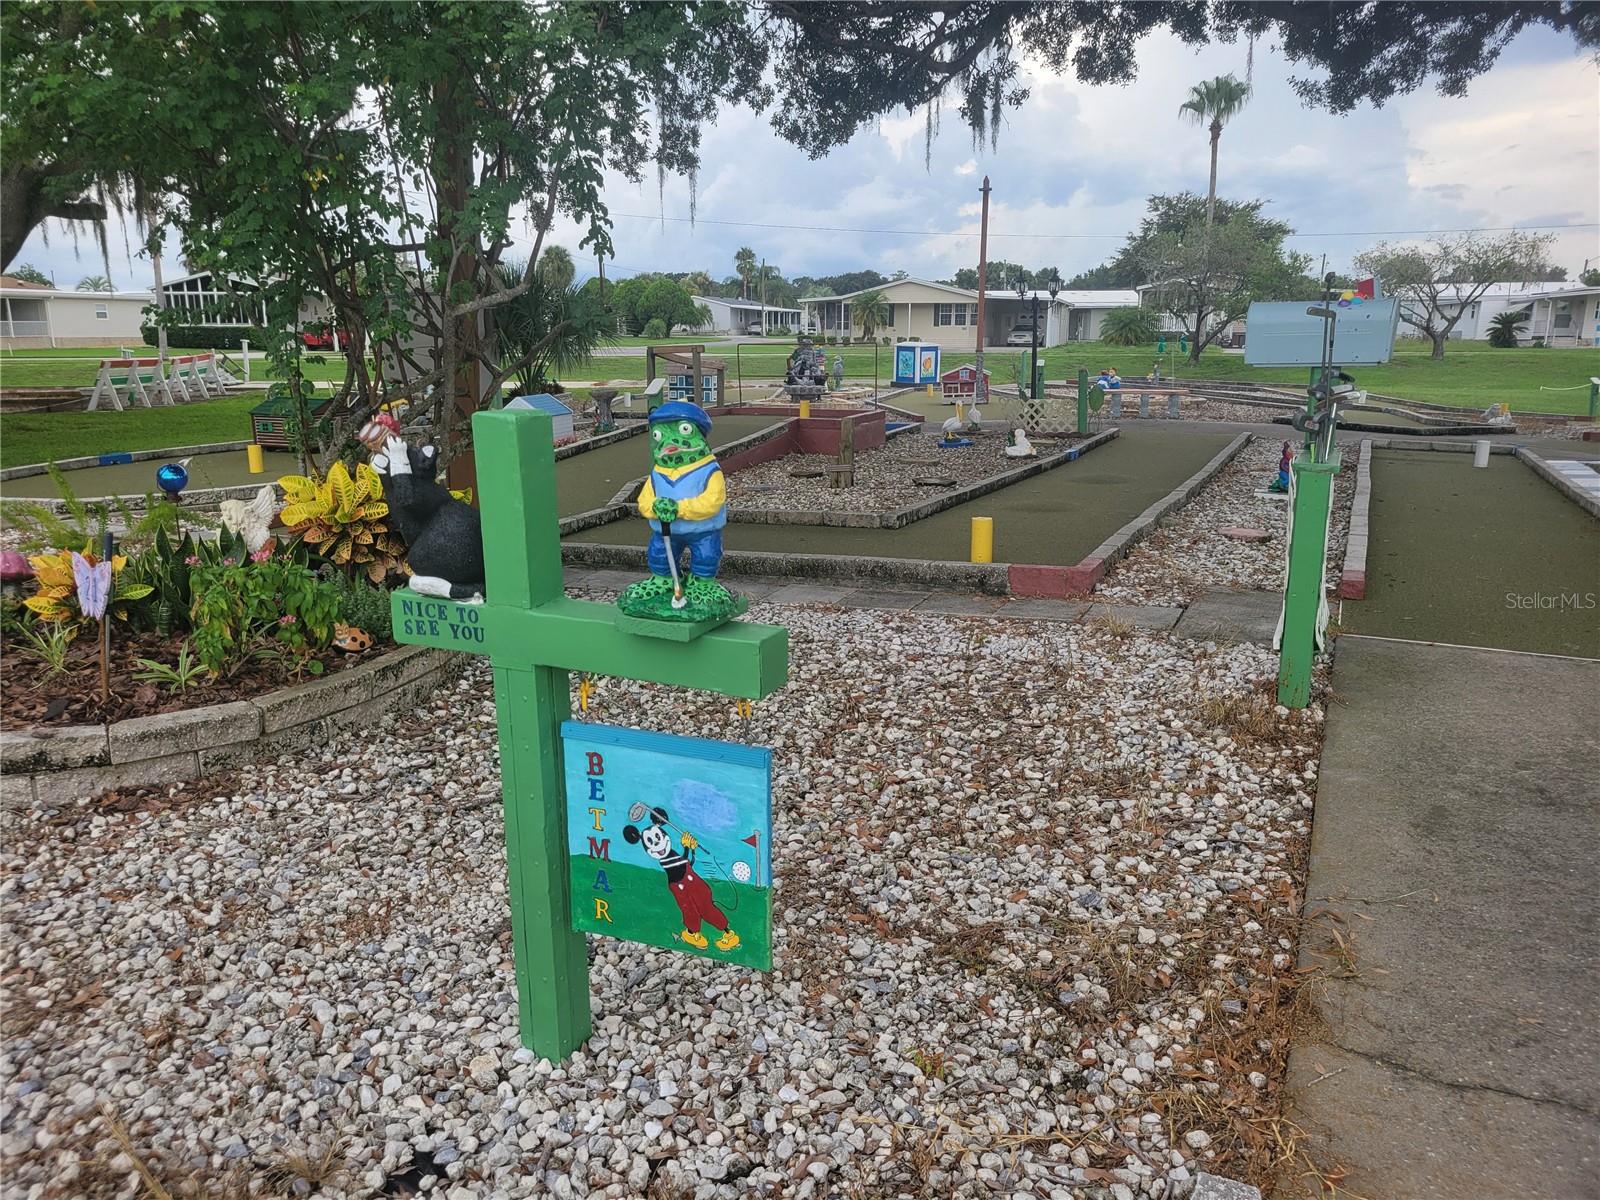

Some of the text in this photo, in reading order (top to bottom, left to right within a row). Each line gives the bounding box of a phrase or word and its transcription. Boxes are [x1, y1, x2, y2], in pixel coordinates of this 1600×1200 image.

[402, 600, 479, 624] NICE TO
[404, 619, 484, 643] SEE YOU
[585, 751, 614, 924] BETMAR
